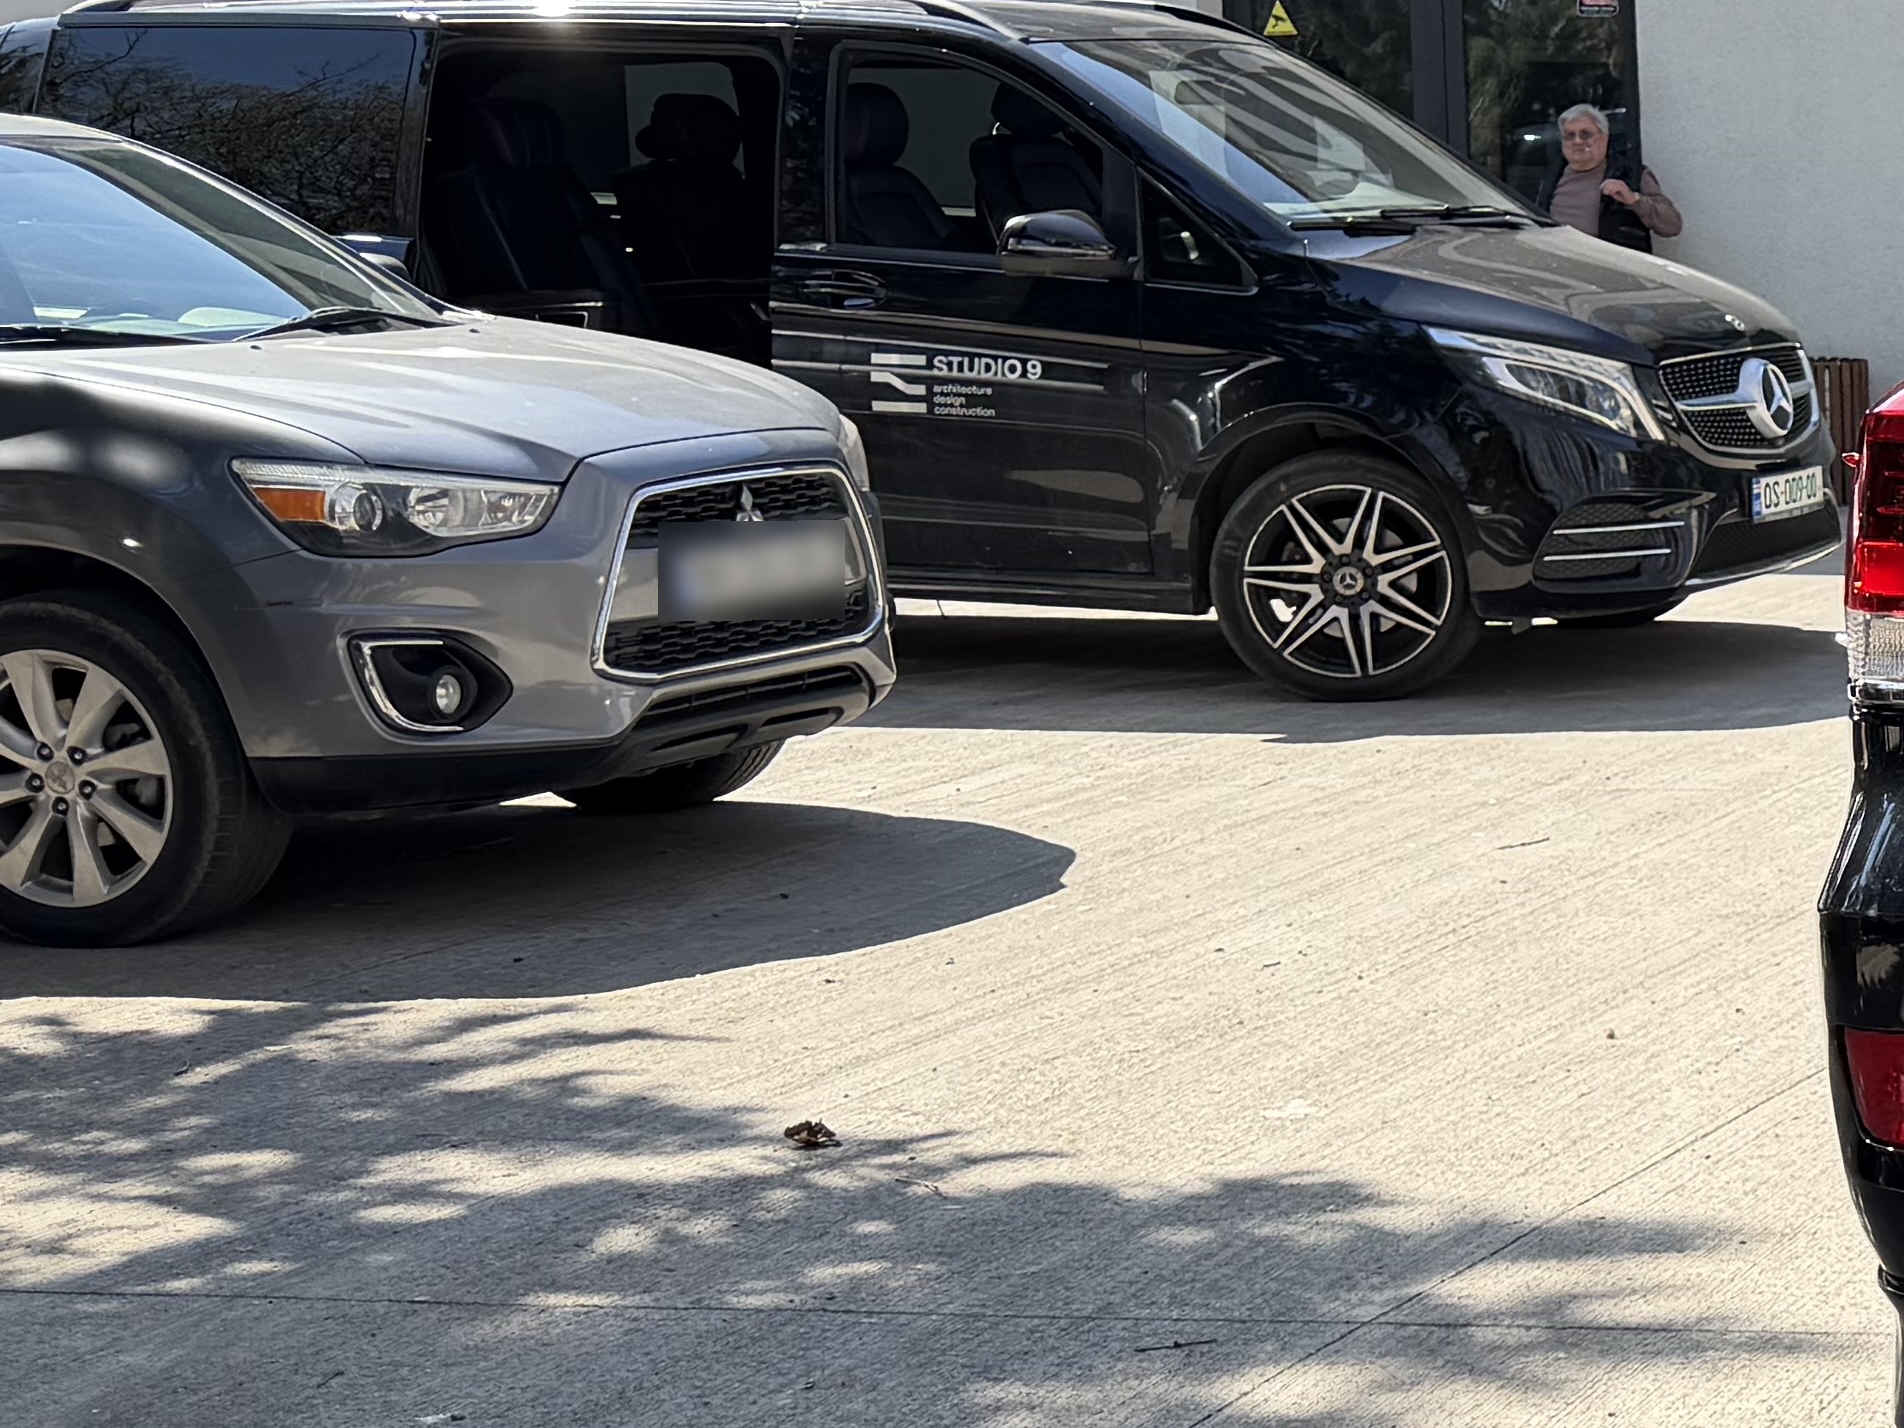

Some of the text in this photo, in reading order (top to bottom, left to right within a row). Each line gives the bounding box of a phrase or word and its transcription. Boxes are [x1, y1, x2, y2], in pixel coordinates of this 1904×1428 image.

[932, 354, 1042, 380] STUDIO 9
[932, 383, 993, 396] architecture
[932, 394, 966, 406] design
[934, 405, 996, 417] construction
